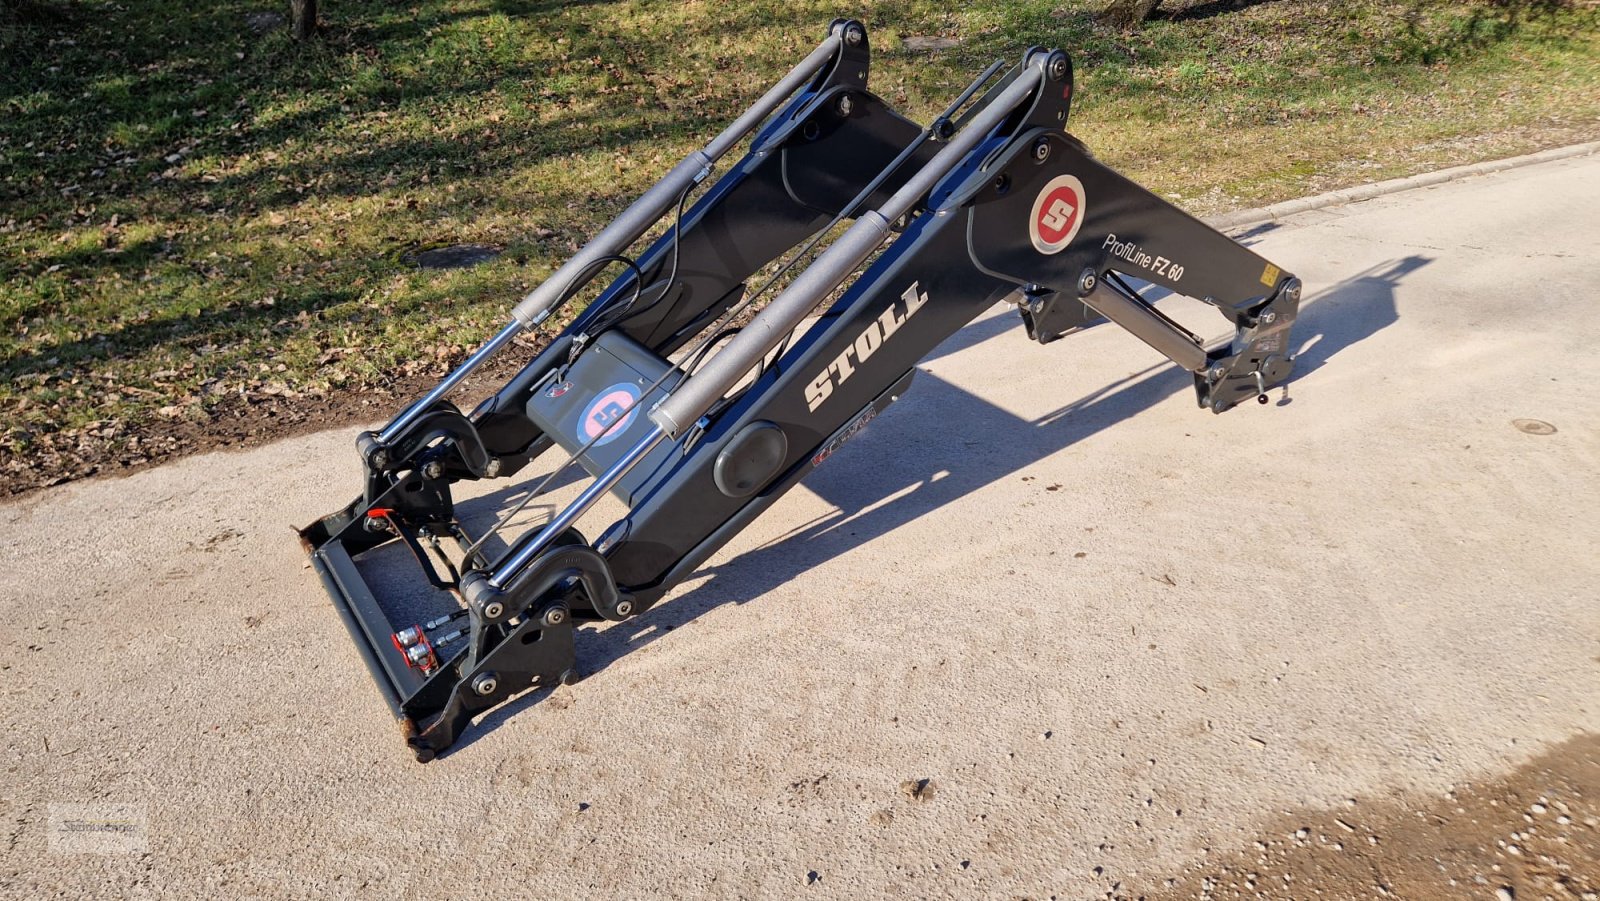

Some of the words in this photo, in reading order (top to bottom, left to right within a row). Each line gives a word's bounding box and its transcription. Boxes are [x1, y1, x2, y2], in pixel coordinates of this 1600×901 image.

[1042, 198, 1075, 232] S
[1102, 233, 1152, 268] ProfiLine
[1150, 256, 1171, 276] FZ
[1167, 263, 1185, 282] 60
[804, 280, 929, 413] STOLL
